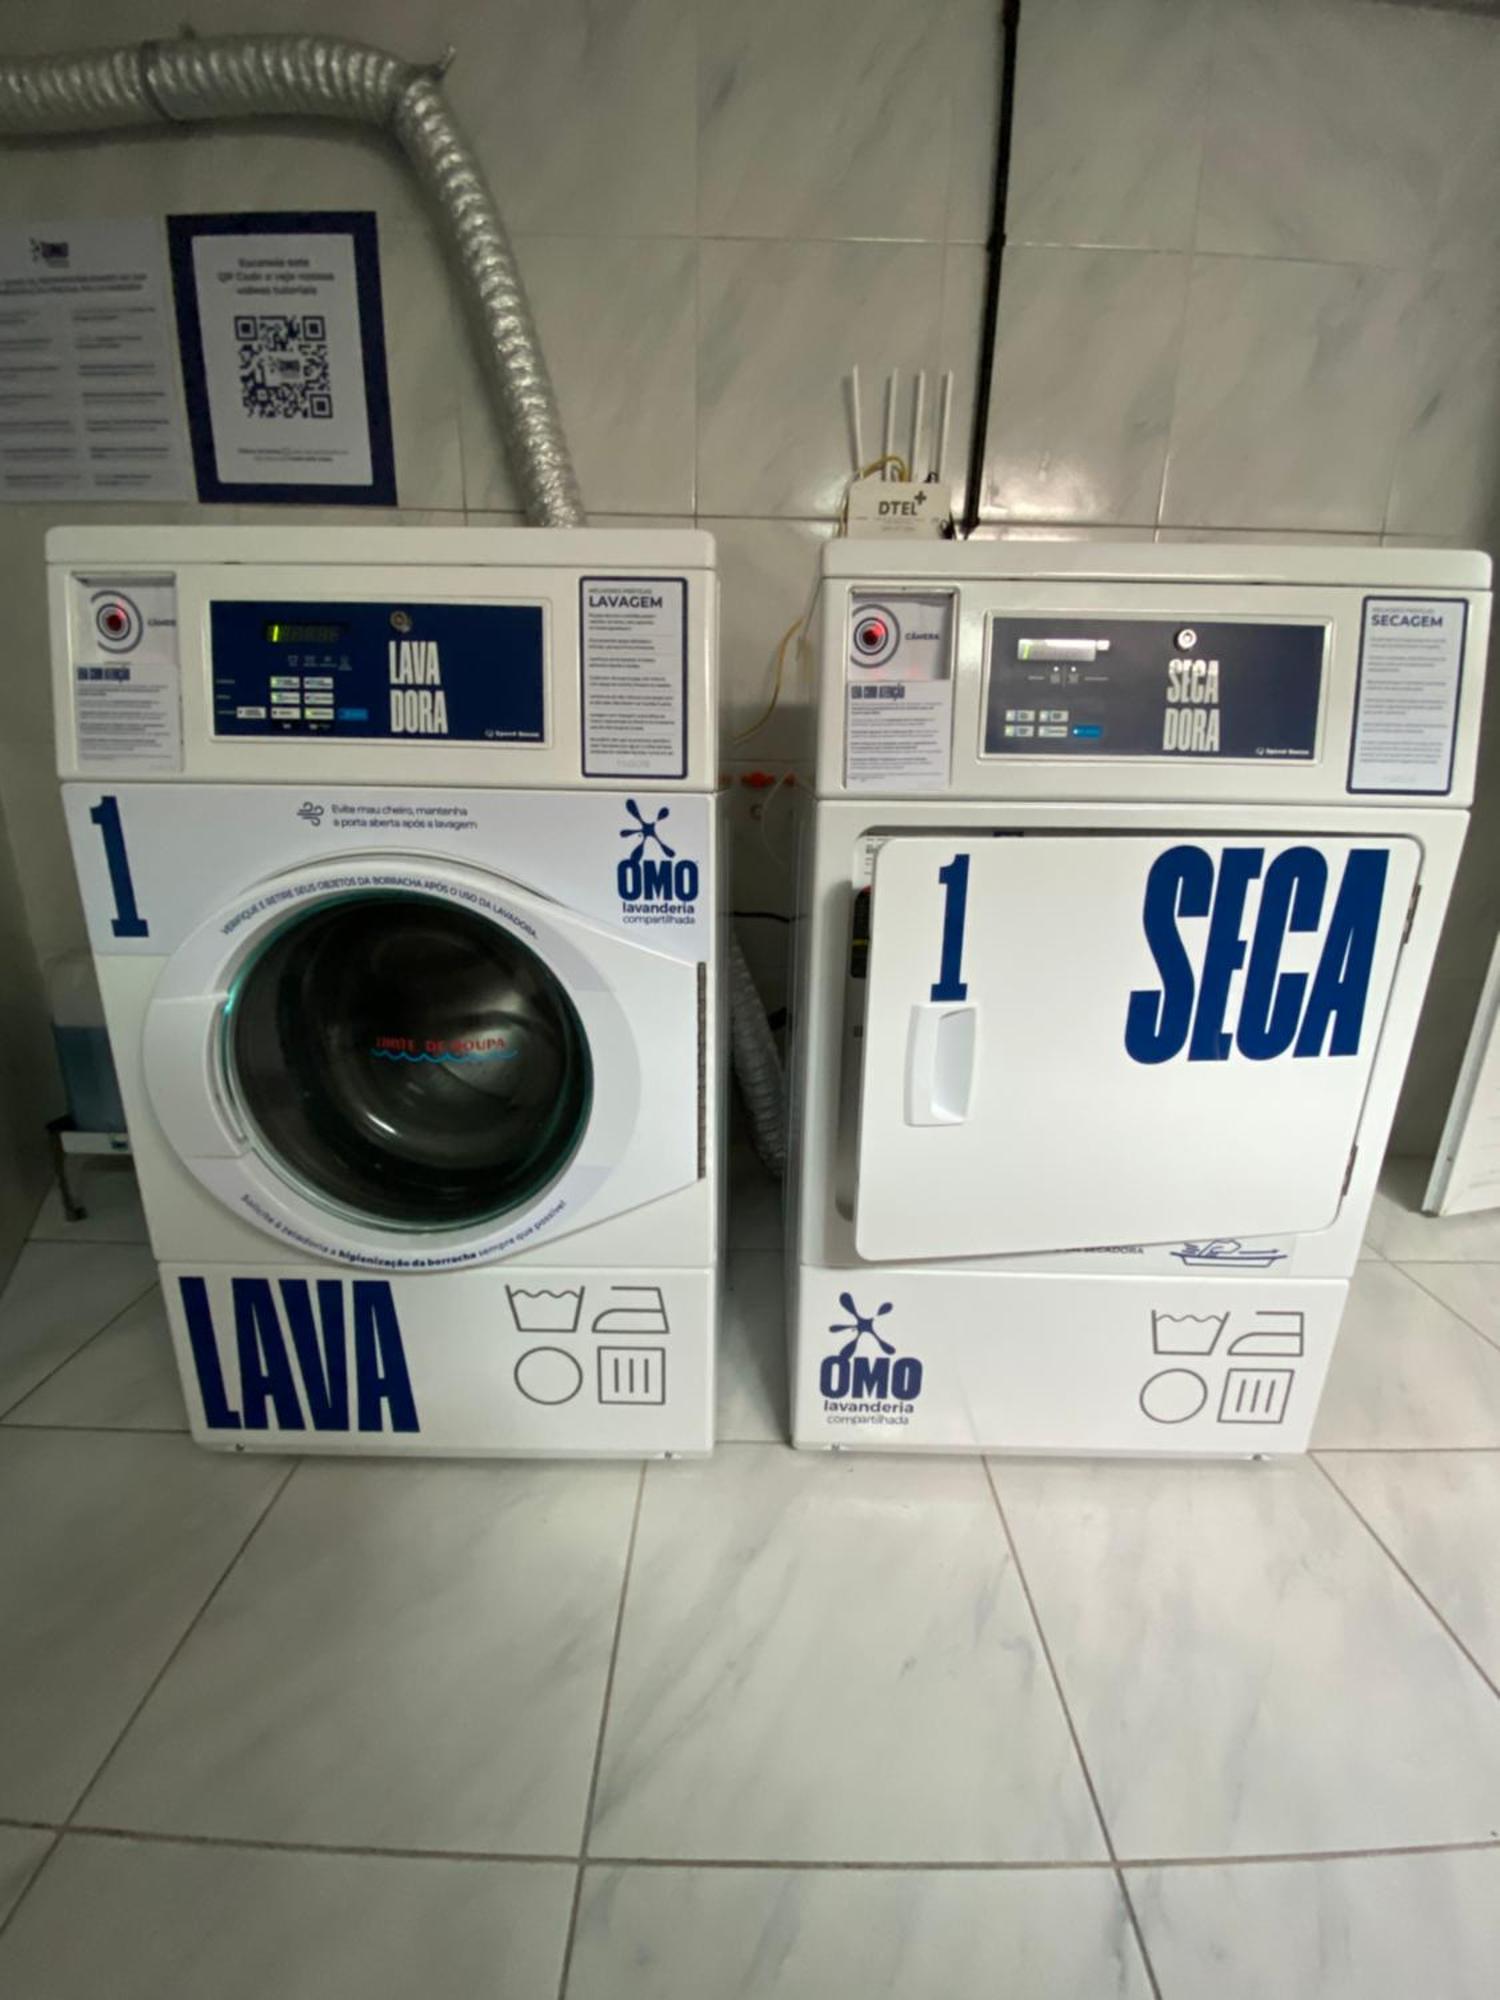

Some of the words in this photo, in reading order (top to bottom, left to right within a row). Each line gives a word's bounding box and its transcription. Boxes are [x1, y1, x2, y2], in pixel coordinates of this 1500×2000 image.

[589, 595, 662, 608] LAVAGEM
[1370, 614, 1443, 627] SECAGEM
[388, 640, 441, 685] LAVA
[1166, 659, 1219, 704] SECA
[390, 689, 449, 734] DORA
[1162, 708, 1220, 752] DORA
[331, 803, 355, 814] Evite
[357, 806, 380, 814] mau
[416, 805, 468, 816] mantenha
[341, 819, 367, 828] porta
[369, 818, 400, 828] aberta
[402, 819, 425, 829] após
[434, 819, 478, 831] lavagem
[89, 795, 149, 938] 1
[617, 860, 698, 902] OMO
[357, 876, 370, 885] DA
[373, 876, 422, 887] BORRACHA
[423, 878, 450, 893] APÓS
[477, 897, 491, 908] DA
[622, 902, 695, 914] lavanderia
[623, 914, 696, 925] compartilhada
[930, 853, 970, 1002] 1
[1124, 845, 1390, 1065] SECA
[336, 1248, 409, 1268] higienização
[412, 1258, 425, 1267] da
[427, 1250, 476, 1266] borracha
[178, 1276, 420, 1433] LAVA
[819, 1355, 923, 1400] OMO
[823, 1400, 914, 1413] lavanderia
[827, 1414, 910, 1425] compartilhada
